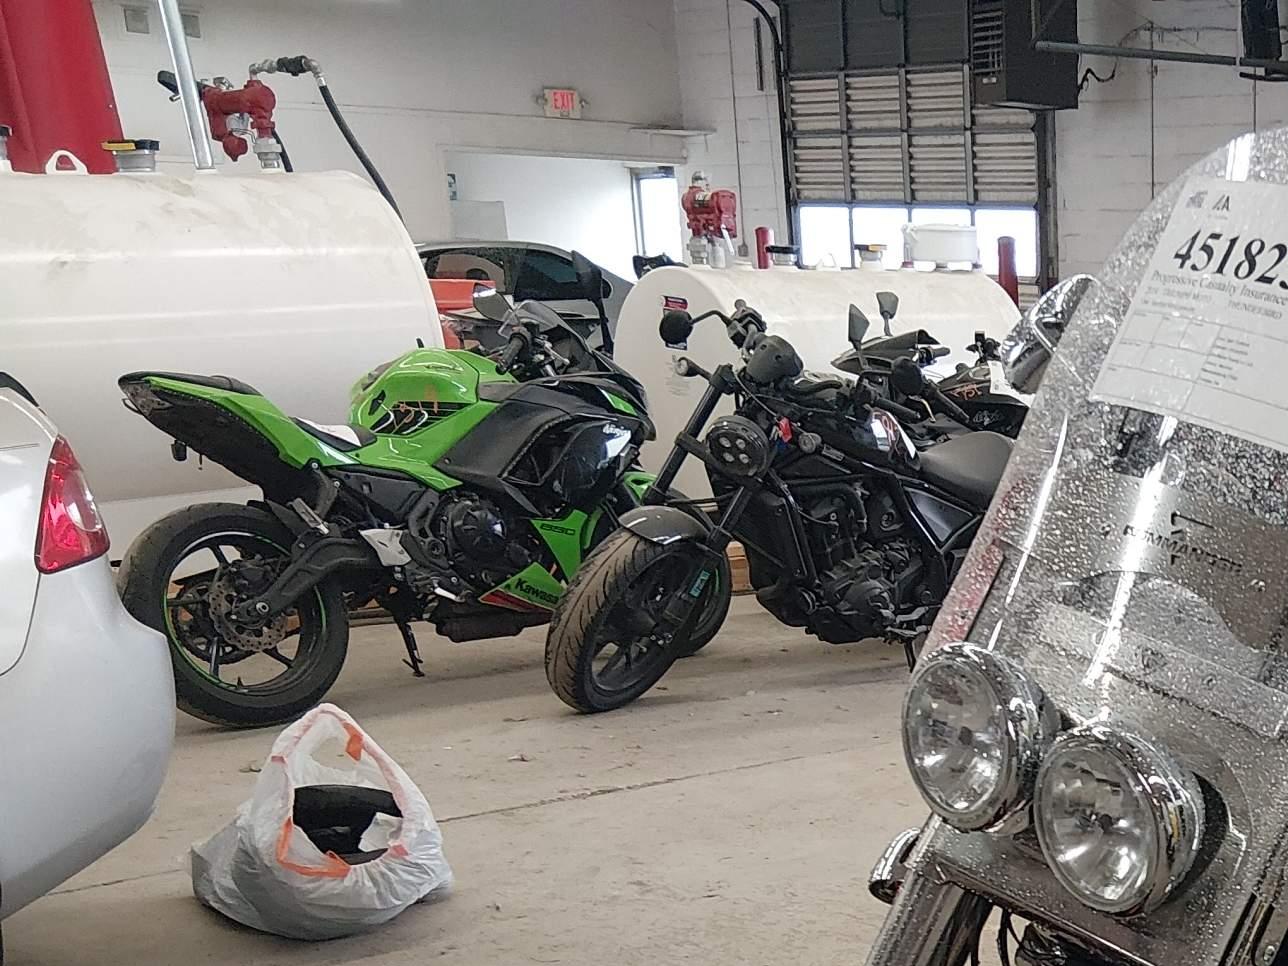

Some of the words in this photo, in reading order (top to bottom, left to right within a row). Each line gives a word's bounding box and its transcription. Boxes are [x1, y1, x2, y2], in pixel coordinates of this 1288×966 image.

[553, 91, 576, 110] EXIT
[1200, 277, 1237, 297] Casualty
[1240, 285, 1288, 306] Insurance
[515, 577, 560, 605] Kawasa
